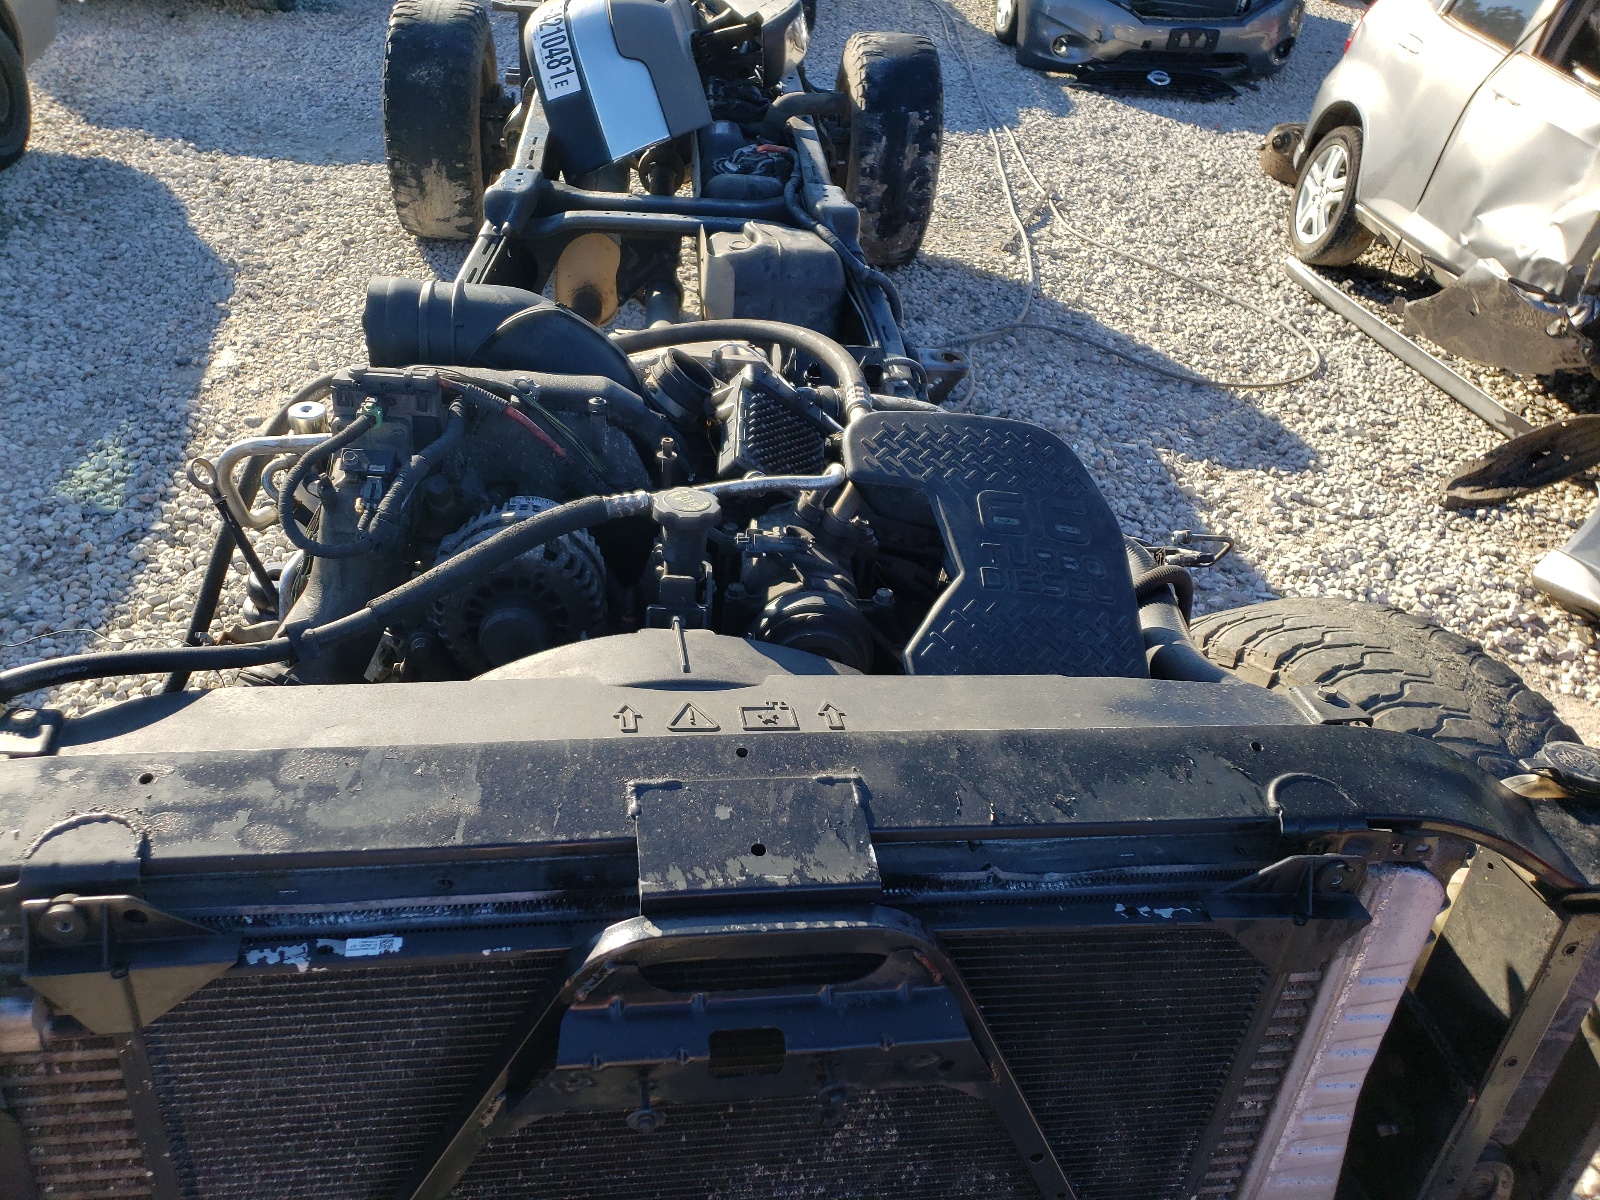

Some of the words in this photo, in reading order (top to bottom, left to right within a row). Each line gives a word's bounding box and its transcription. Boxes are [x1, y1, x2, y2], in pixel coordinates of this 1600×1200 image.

[555, 79, 569, 89] E
[977, 489, 1092, 546] 6.0
[980, 542, 1107, 580] TURBO
[980, 566, 1115, 604] DIESEL
